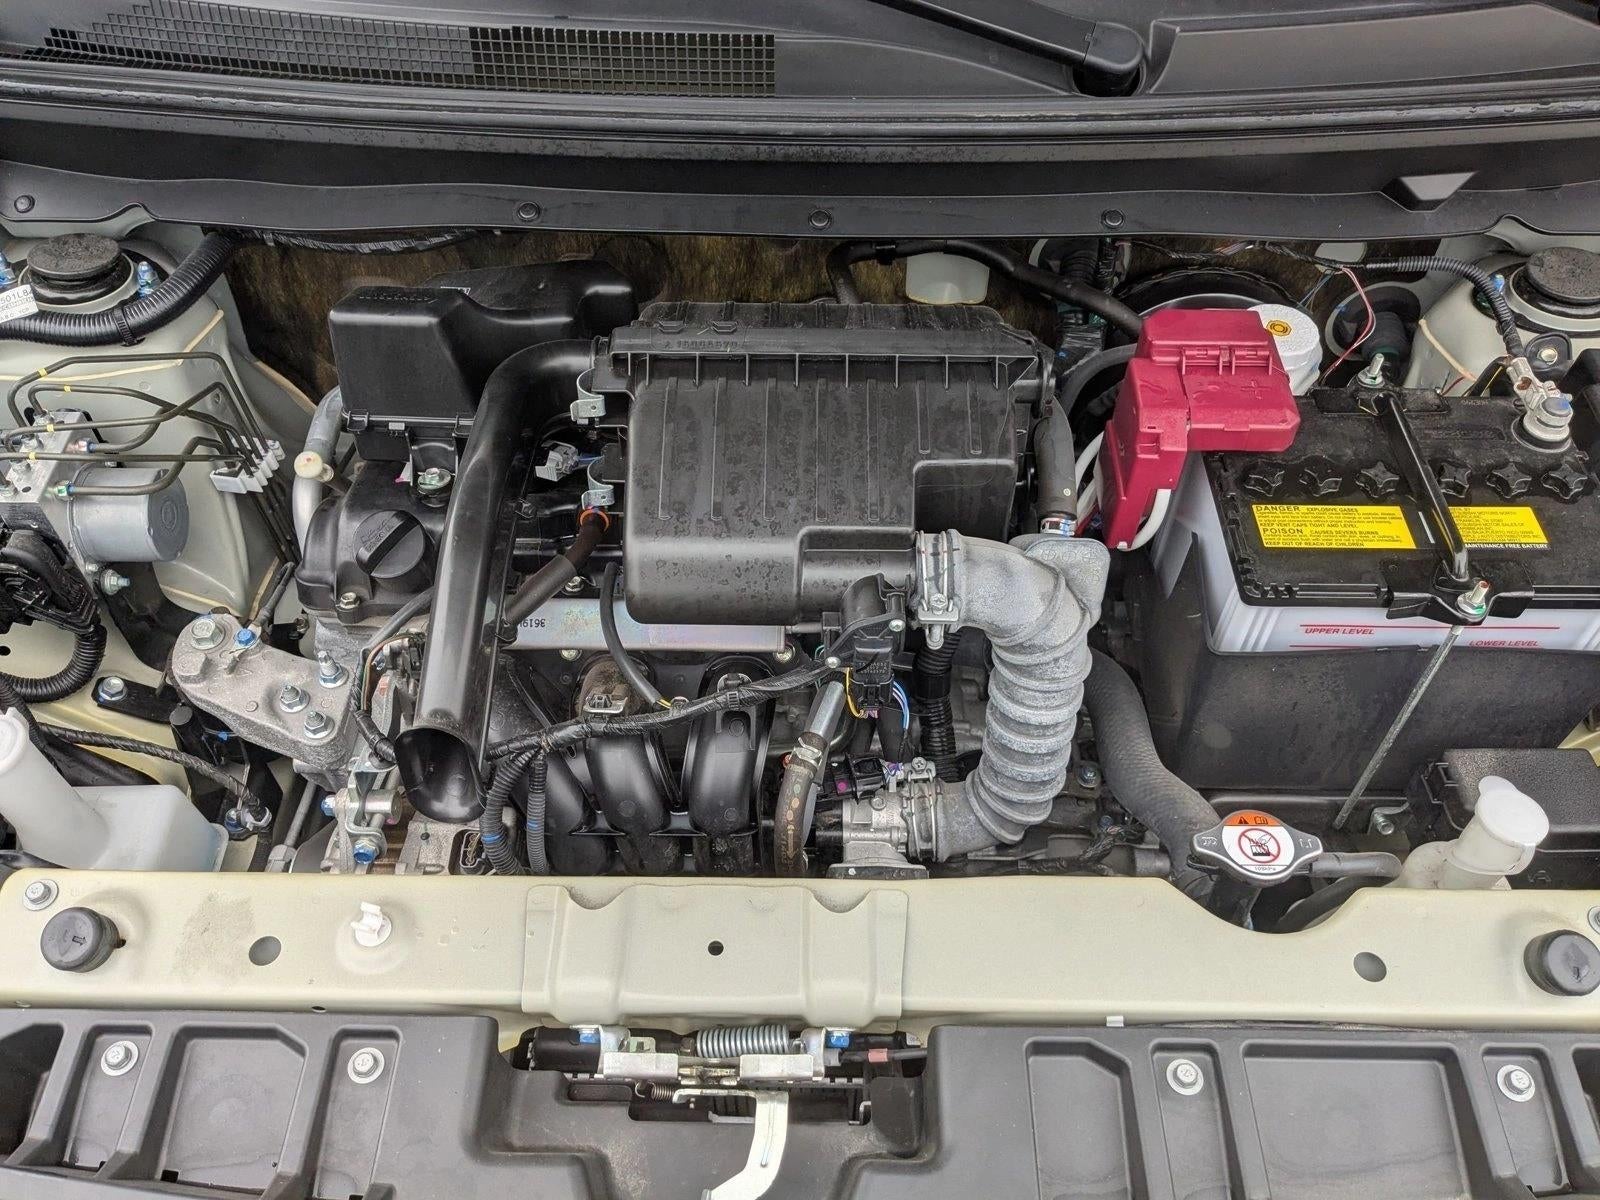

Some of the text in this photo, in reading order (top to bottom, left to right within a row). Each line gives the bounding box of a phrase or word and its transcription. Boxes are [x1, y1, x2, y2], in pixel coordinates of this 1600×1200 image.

[1262, 527, 1304, 535] POISON
[1304, 627, 1375, 636] UPPER LEVEL
[1468, 639, 1539, 648] LOWER LEVEL
